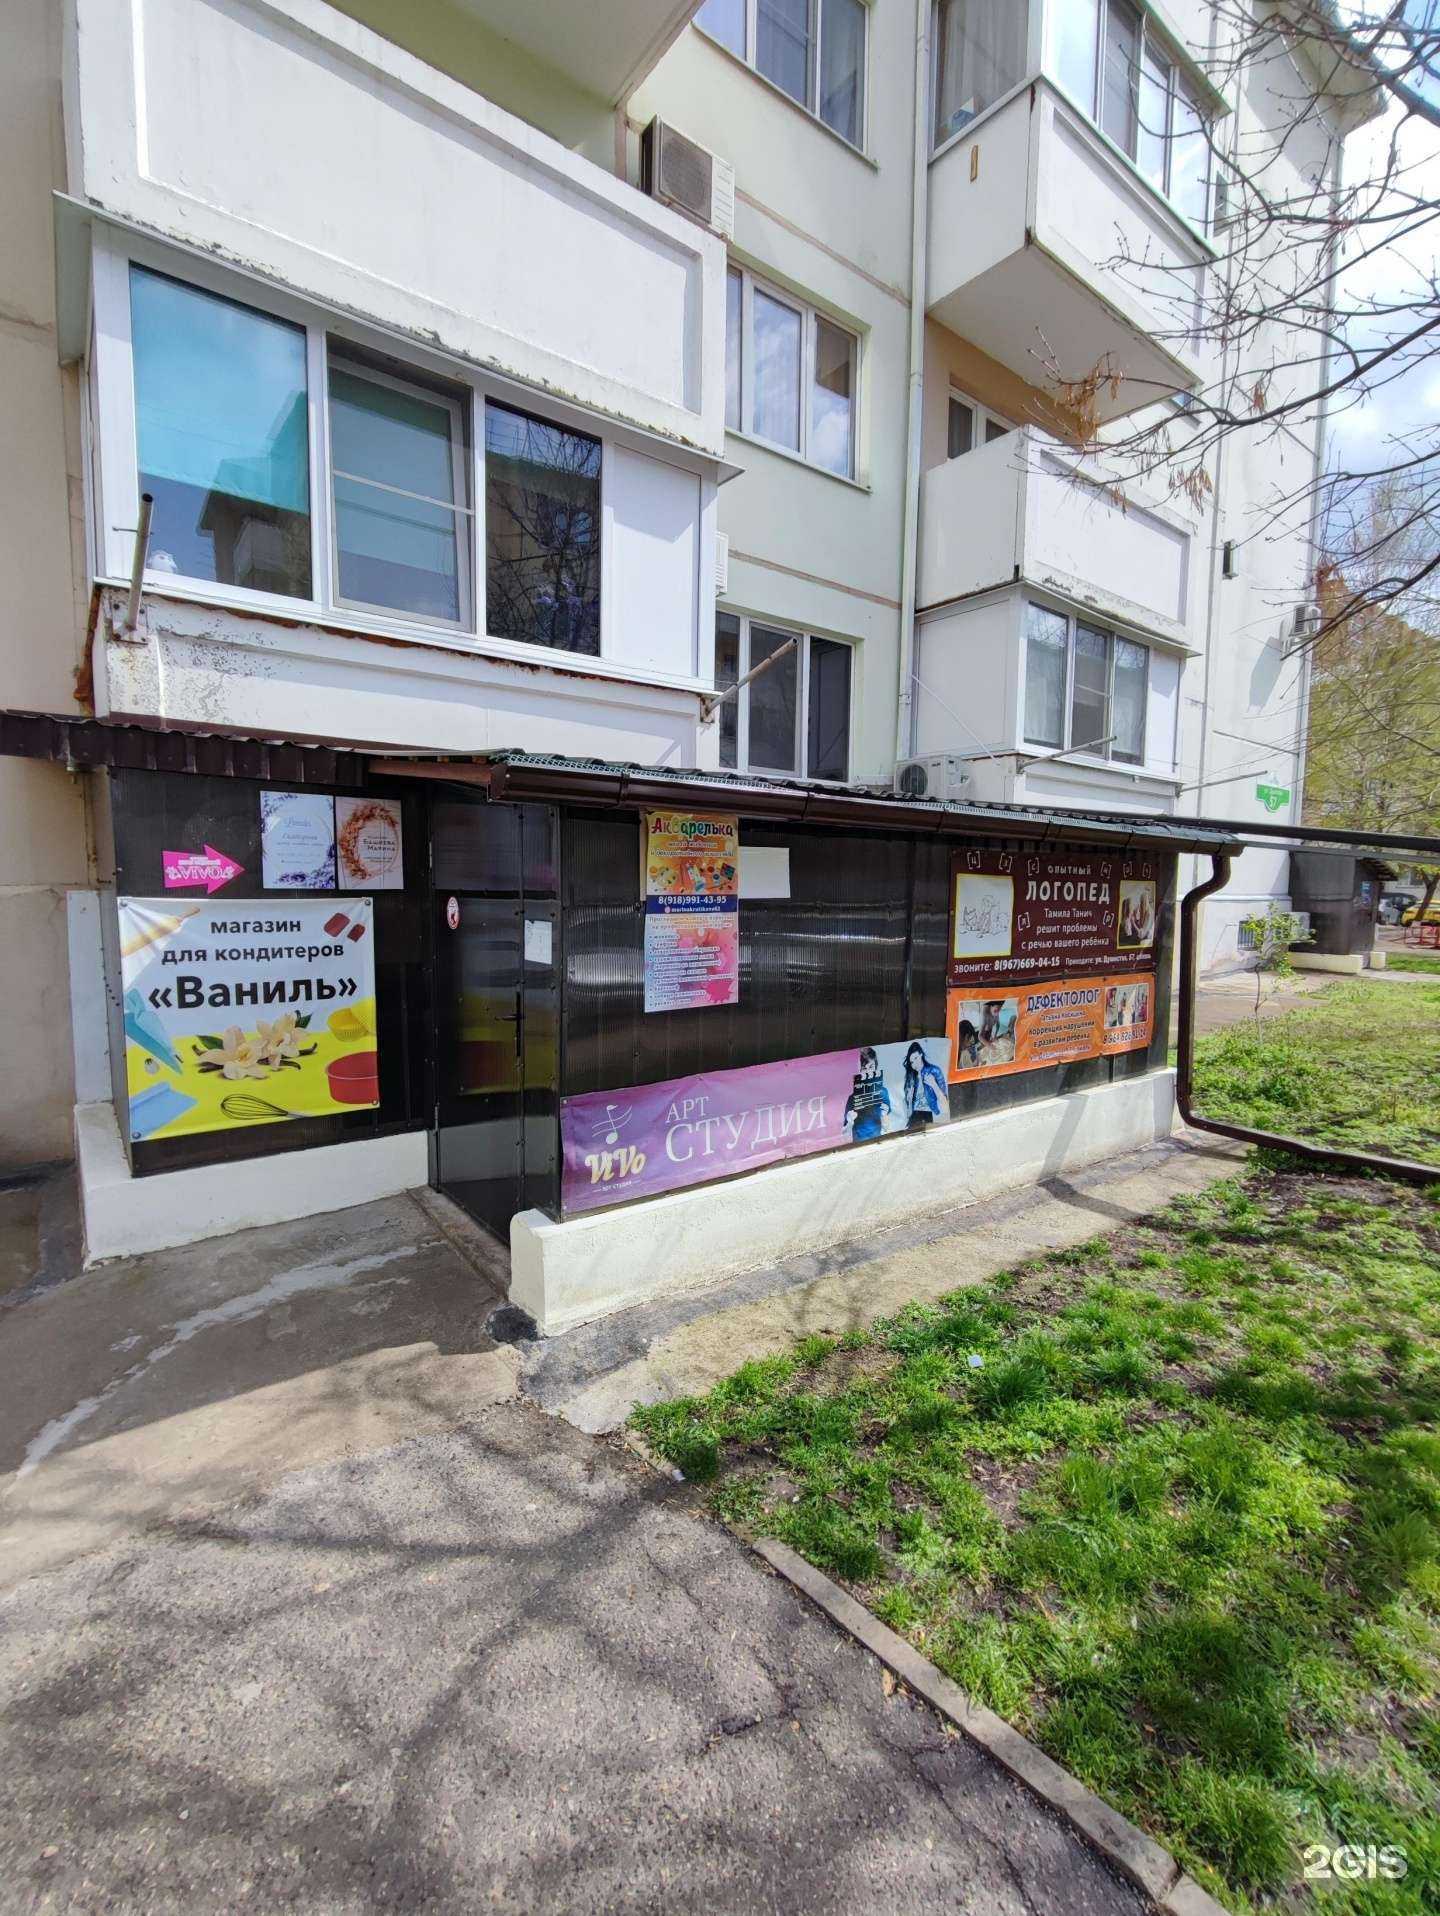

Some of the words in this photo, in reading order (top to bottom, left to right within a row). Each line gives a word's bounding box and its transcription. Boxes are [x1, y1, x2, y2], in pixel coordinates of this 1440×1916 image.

[1047, 864, 1091, 875] опытный
[1025, 880, 1110, 904] ЛОГОПЕД
[1044, 908, 1070, 918] Тамила
[210, 919, 301, 934] магазин
[1036, 926, 1060, 935] решит
[1062, 923, 1098, 934] проблемы
[161, 949, 207, 965] для
[215, 943, 344, 962] кондитеров
[1021, 941, 1027, 949] с
[1028, 940, 1052, 951] речью
[1054, 939, 1080, 948] вашего
[148, 975, 358, 1010] «Ваниль»
[1027, 989, 1099, 1011] ДЕФЕКТОЛОГ
[664, 1096, 710, 1124] АРТ
[664, 1095, 827, 1162] СТУДИЯ
